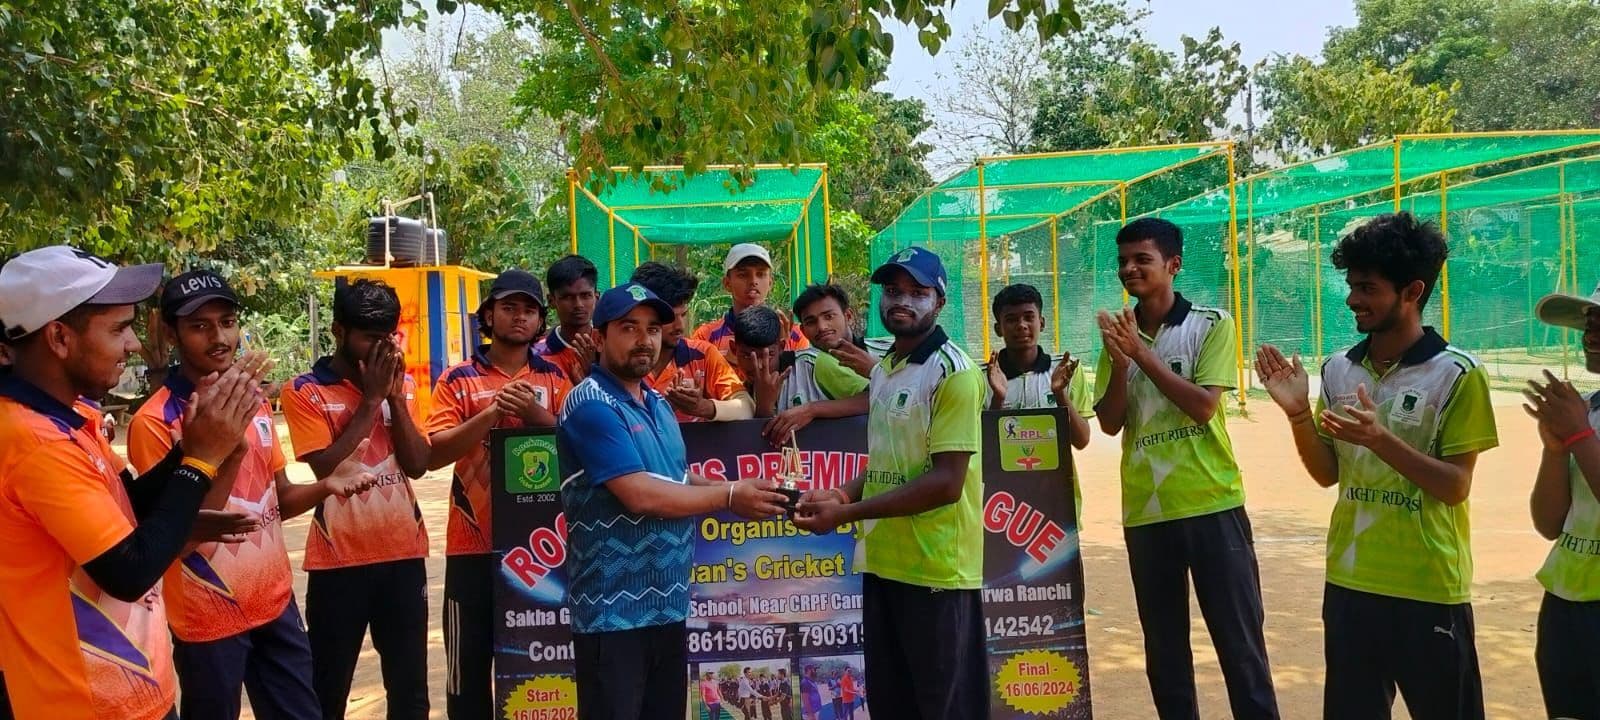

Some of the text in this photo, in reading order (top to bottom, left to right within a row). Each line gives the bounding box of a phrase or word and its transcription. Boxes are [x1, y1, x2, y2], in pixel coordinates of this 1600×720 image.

[1381, 490, 1420, 514] RIDRS
[701, 505, 812, 545] Organis
[983, 490, 1066, 565] GUE
[690, 552, 846, 584] an's Cricket
[981, 583, 1072, 603] rwa Ranchi
[690, 598, 747, 618] School,
[749, 595, 787, 615] Near
[789, 592, 829, 612] CRPF
[505, 608, 557, 629] Sakha
[984, 615, 1055, 638] 142542
[799, 623, 864, 648] 79031
[1018, 663, 1050, 676] Final
[526, 688, 560, 703] Start
[1004, 680, 1074, 698] 16/06/2024
[512, 706, 578, 720] 16/05/202
